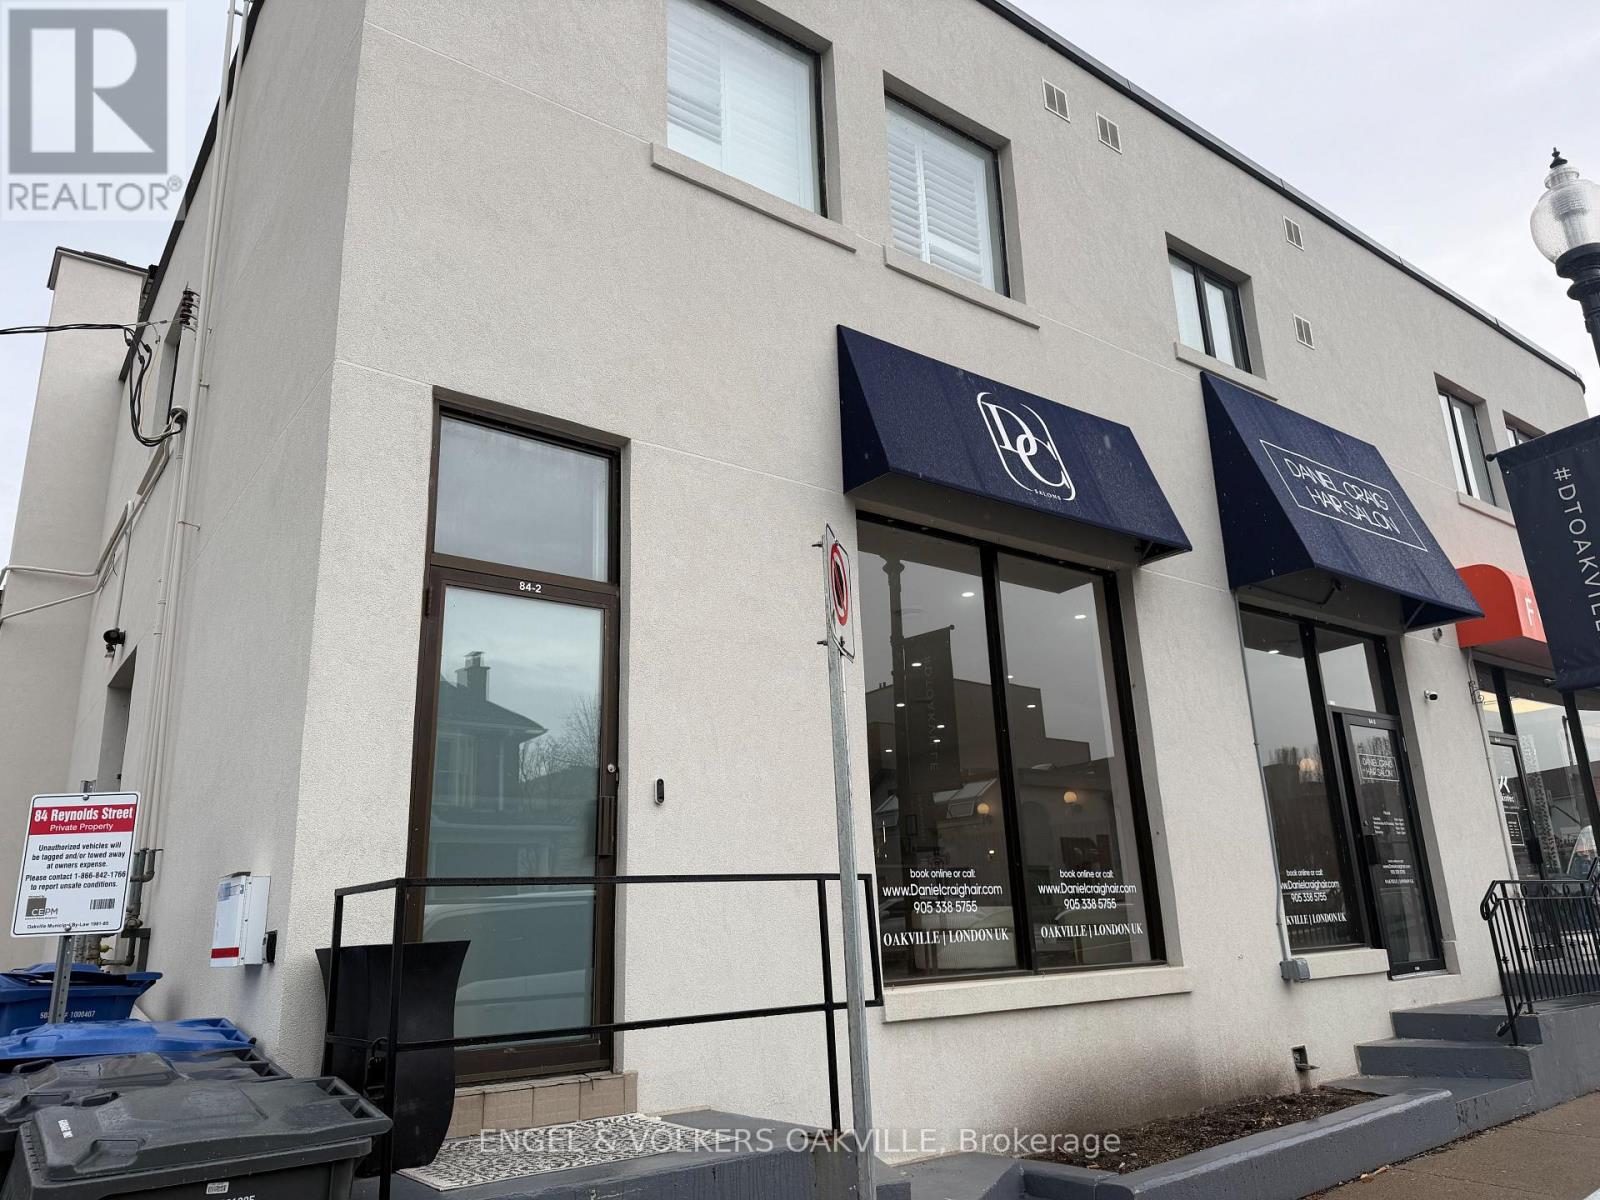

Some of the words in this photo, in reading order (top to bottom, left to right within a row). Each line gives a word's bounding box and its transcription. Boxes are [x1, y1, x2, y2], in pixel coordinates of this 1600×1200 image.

[1284, 458, 1346, 496] DANIEL
[1342, 482, 1389, 511] CRAIG
[1305, 486, 1348, 515] HAIR
[1343, 500, 1401, 534] SALON
[519, 581, 542, 593] 84-2
[34, 810, 48, 822] 84
[51, 808, 99, 822] Reynolds
[102, 807, 133, 819] Street
[50, 823, 78, 832] Private
[79, 823, 113, 832] Property
[38, 843, 81, 851] Unauthorized
[82, 842, 108, 850] vehicles
[110, 841, 122, 849] will
[41, 853, 64, 862] tagged
[65, 852, 87, 860] and/or
[88, 851, 107, 859] towed
[109, 851, 126, 859] away
[48, 873, 73, 881] contact
[910, 869, 930, 879] book
[931, 868, 952, 879] online
[1059, 869, 1075, 879] book
[1076, 869, 1094, 878] online
[1286, 869, 1298, 877] book
[38, 883, 59, 891] report
[60, 882, 82, 890] unsafe
[882, 883, 1003, 897] www.Danielcraighair.com
[1038, 882, 1137, 896] www.Danielcraighair.com
[1291, 893, 1303, 903] 905
[1303, 892, 1313, 902] 338
[1313, 892, 1327, 902] 5755
[913, 901, 934, 914] 905
[935, 901, 953, 913] 338
[955, 901, 978, 913] 5755
[1063, 898, 1081, 910] 905
[1081, 898, 1097, 910] 338
[1098, 898, 1117, 909] 5755
[1285, 914, 1307, 926] KVILLE
[1312, 913, 1338, 924] LONDON
[1040, 924, 1088, 939] OAKVILLE
[1094, 923, 1130, 937] LONDON
[1131, 922, 1144, 935] UK
[883, 930, 941, 947] OAKVILLE
[949, 929, 994, 944] LONDON
[994, 928, 1010, 942] UK
